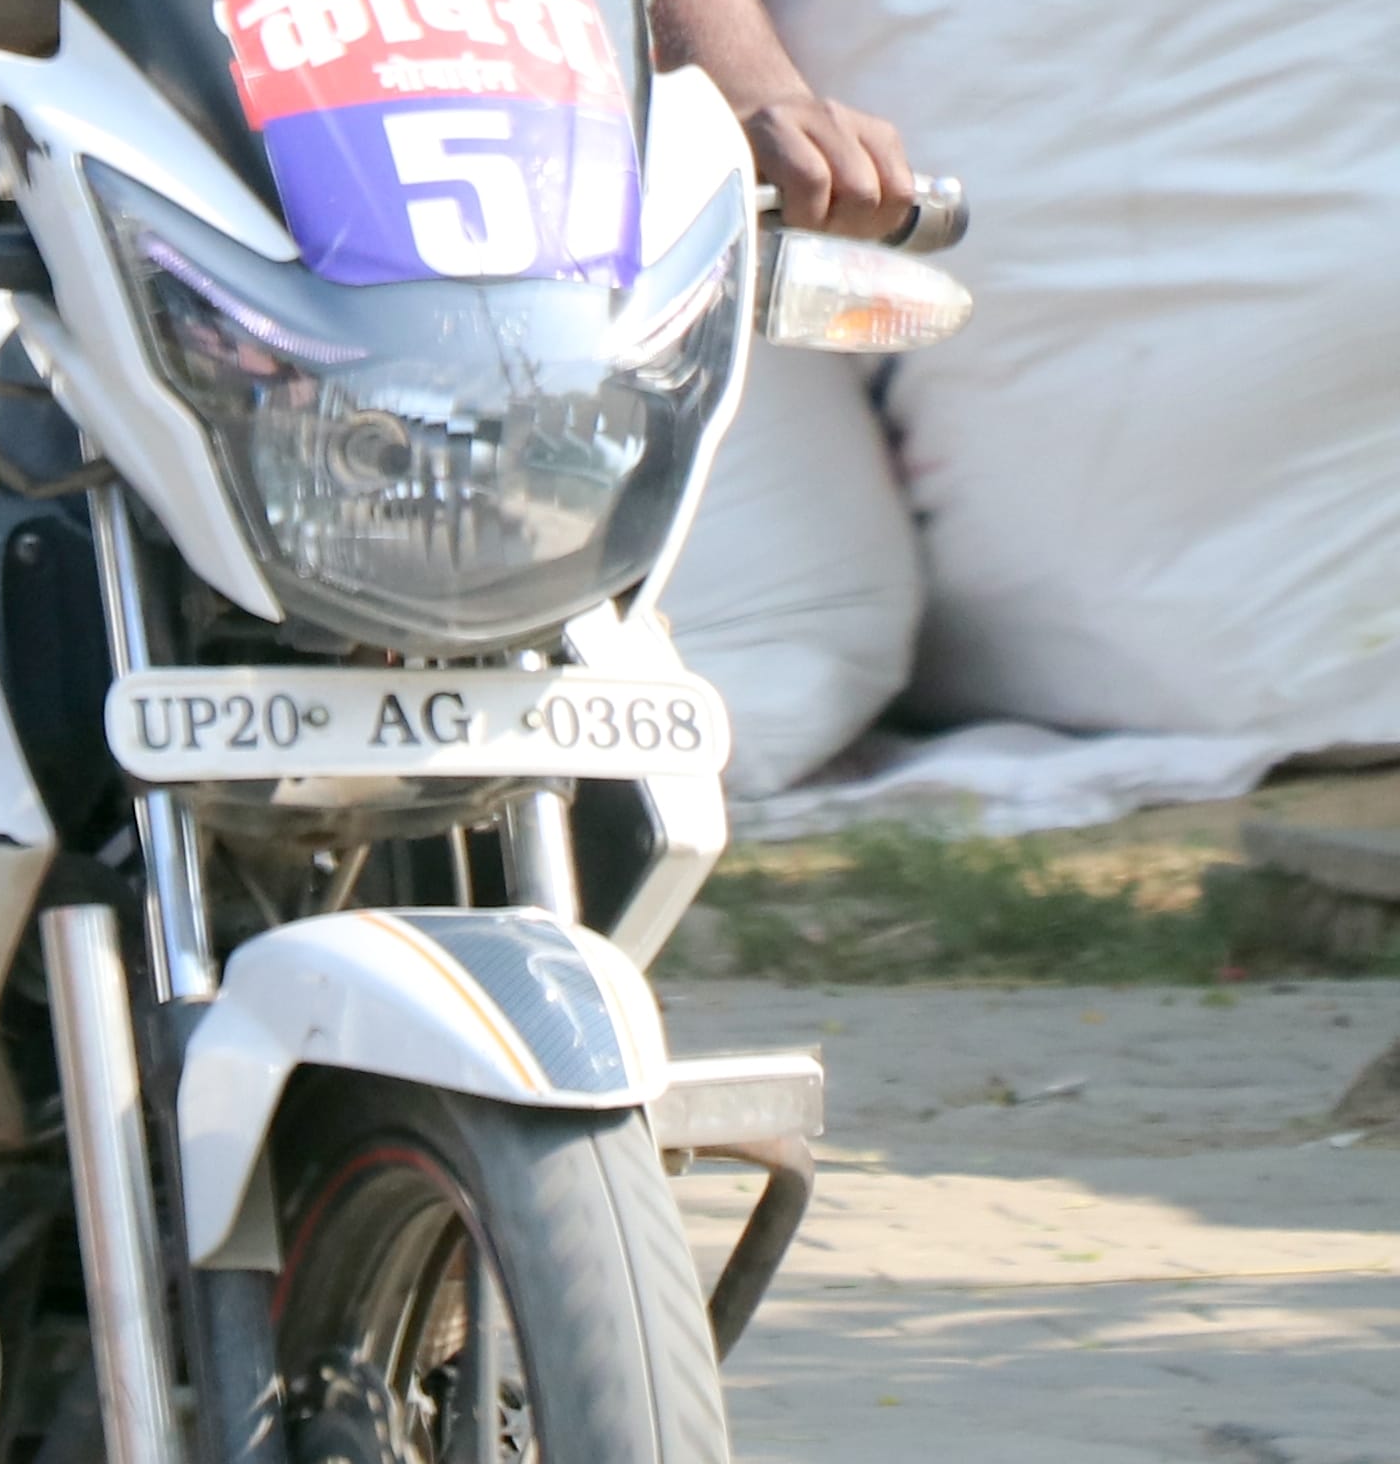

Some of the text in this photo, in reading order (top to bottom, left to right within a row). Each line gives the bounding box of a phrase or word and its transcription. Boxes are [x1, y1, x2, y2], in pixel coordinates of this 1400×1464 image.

[382, 108, 537, 277] 5
[132, 691, 702, 752] UP20 AG 0368
